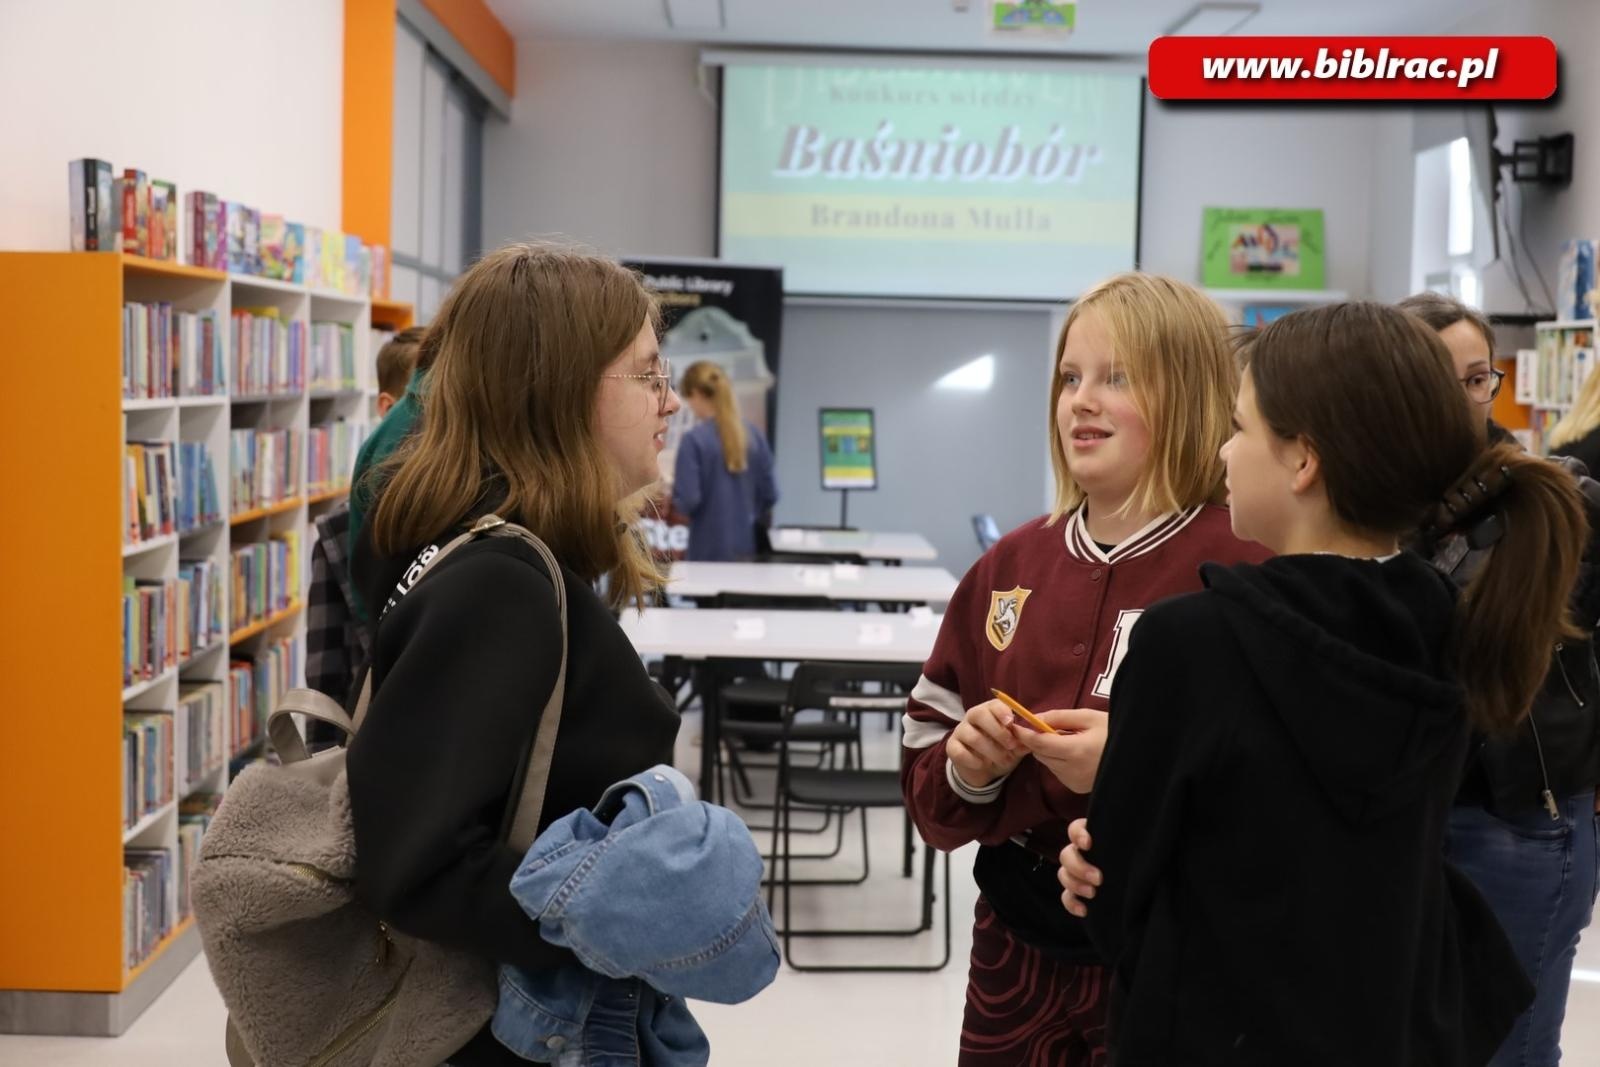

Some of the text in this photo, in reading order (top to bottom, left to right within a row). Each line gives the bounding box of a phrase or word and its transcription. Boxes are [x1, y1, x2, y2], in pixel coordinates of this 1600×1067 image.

[774, 120, 1101, 184] Baśniobór
[810, 204, 1052, 232] Brandona Mulla
[685, 275, 735, 297] Library
